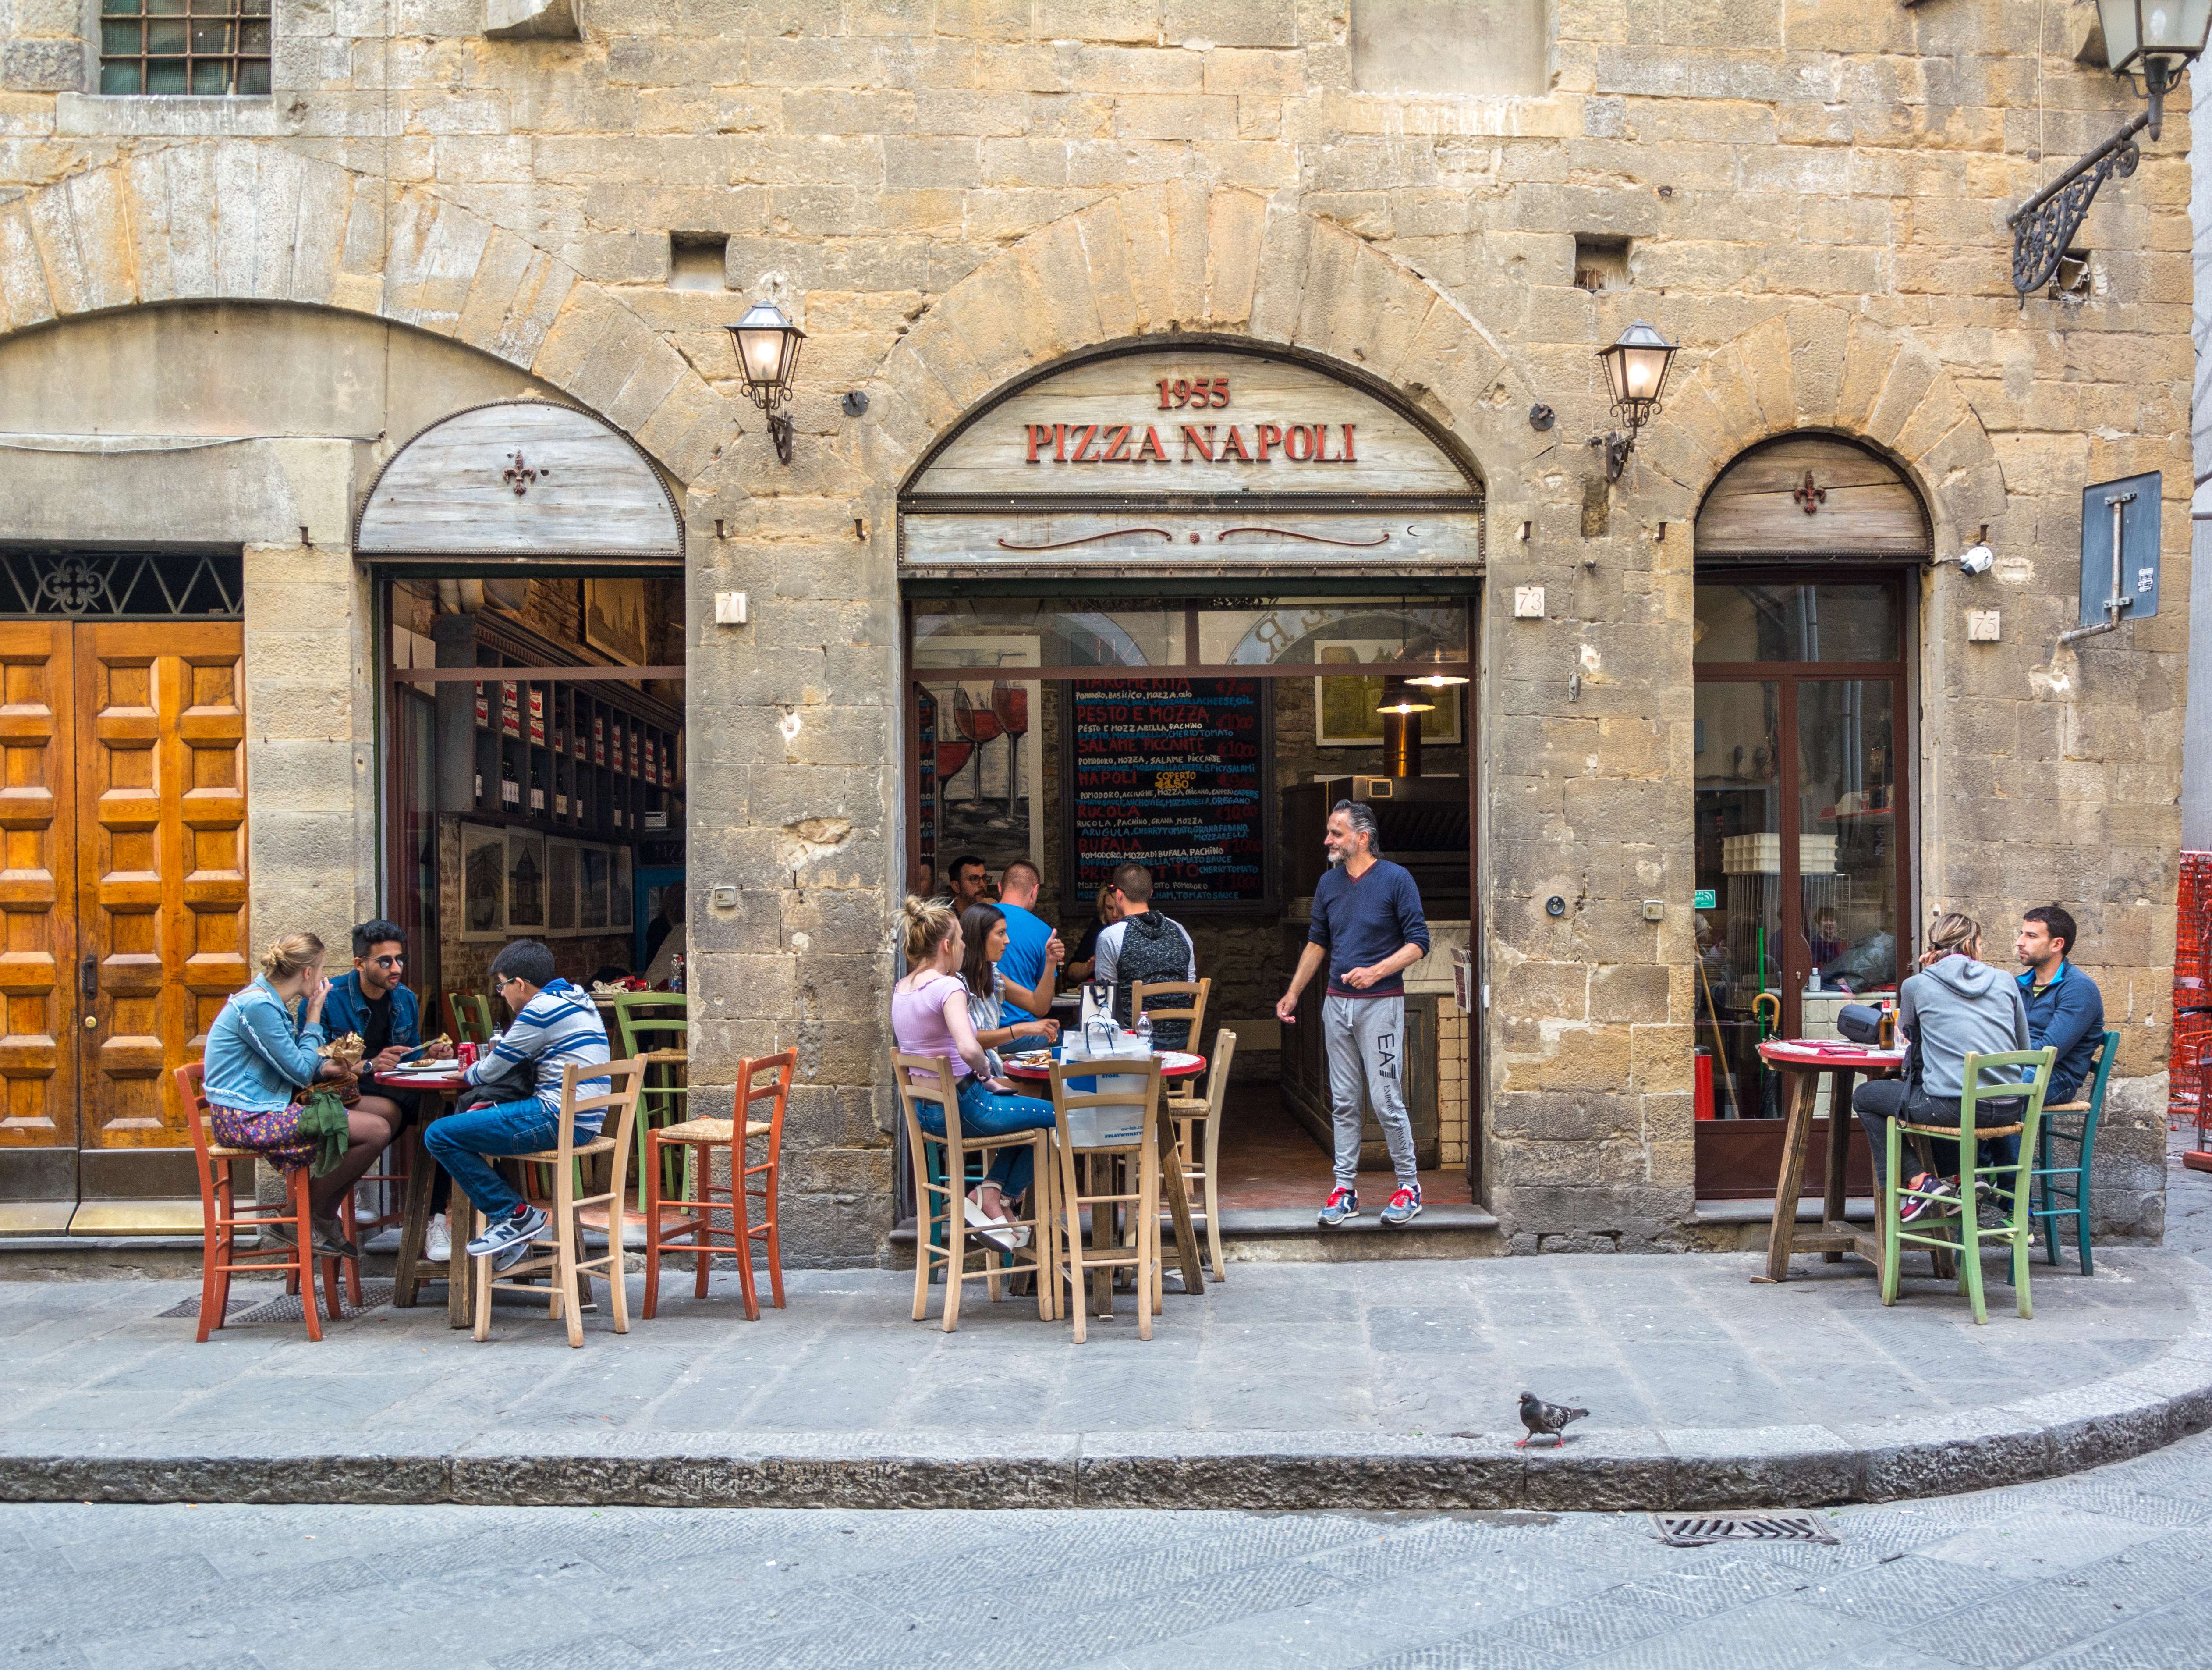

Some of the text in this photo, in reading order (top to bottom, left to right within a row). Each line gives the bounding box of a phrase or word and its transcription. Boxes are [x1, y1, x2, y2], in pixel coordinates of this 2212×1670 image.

[1157, 378, 1230, 409] 1955
[1025, 423, 1357, 463] PIZZA NAPOLI
[721, 598, 740, 617] 71
[1518, 592, 1542, 610] 73
[1974, 618, 1997, 636] 75
[1075, 678, 1191, 691] MARGHERITA
[1076, 705, 1127, 723] PESTO
[1133, 706, 1144, 721] E
[1149, 704, 1209, 723] MOZZA
[1078, 724, 1101, 732] PESTO
[1078, 738, 1137, 753] SALAME
[1143, 737, 1205, 753] PICCANTE
[1150, 756, 1184, 764] SALAME
[1078, 771, 1137, 786] NAPOLI
[1156, 771, 1196, 780] COPERTO
[1212, 796, 1250, 805] OREGANO
[1077, 805, 1141, 818] RUCOLA
[1194, 832, 1249, 841] MOZZARELLA
[1078, 837, 1143, 853] BUFALA
[1080, 858, 1115, 867] BUFFALO
[1170, 855, 1205, 864] TOMATO
[1198, 866, 1227, 874] CHERRY
[1227, 864, 1259, 873] TOMATO
[1172, 881, 1208, 890] POMODORO
[1212, 891, 1240, 899] SAUCE
[1378, 1033, 1396, 1079] EA7
[1383, 1084, 1398, 1119] EMPORIO
[495, 1226, 515, 1240] N
